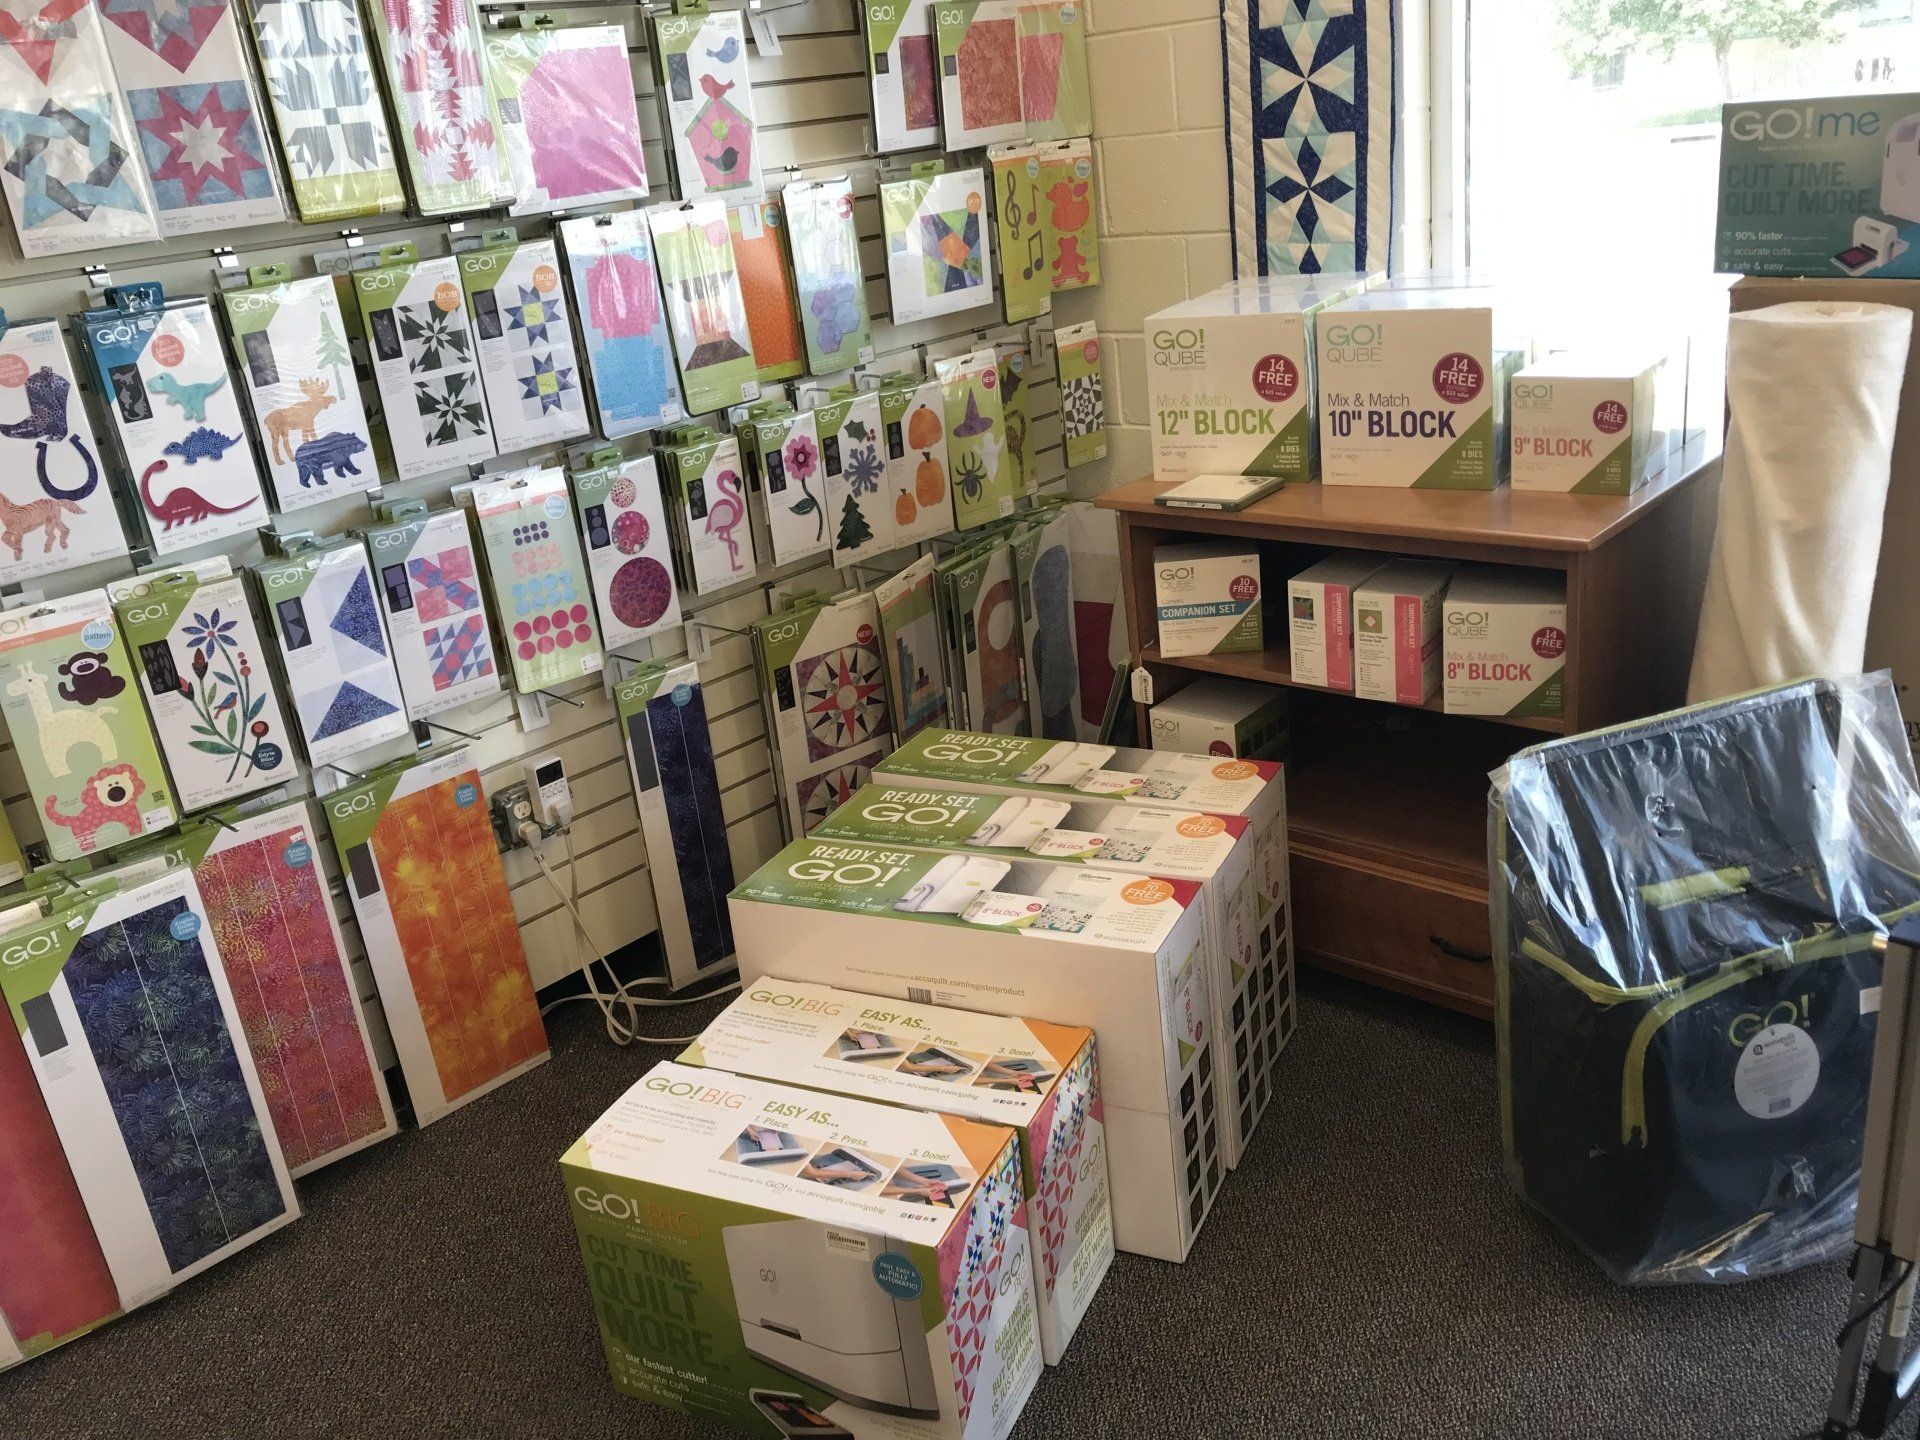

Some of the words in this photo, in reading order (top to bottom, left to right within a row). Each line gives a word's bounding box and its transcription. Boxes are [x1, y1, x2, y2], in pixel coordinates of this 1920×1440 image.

[870, 6, 895, 21] GO!
[940, 10, 964, 25] GO!
[661, 18, 690, 36] GO!
[1726, 164, 1775, 189] CUT
[1724, 191, 1794, 216] QUILT
[1735, 232, 1757, 240] 90%
[1758, 232, 1784, 240] faster
[1734, 248, 1768, 256] accurate
[1771, 248, 1791, 256] cuts
[465, 256, 498, 273] GO!
[1763, 263, 1784, 272] easy
[361, 274, 395, 291] GO!
[96, 324, 138, 345] GO!
[1153, 328, 1204, 350] GO!
[1326, 324, 1383, 346] GO!
[1154, 351, 1206, 366] QUBE
[1326, 347, 1383, 363] QUBE
[1269, 359, 1285, 372] 14
[1451, 357, 1469, 372] 14
[1258, 371, 1293, 387] FREE
[1439, 370, 1478, 388] FREE
[1515, 384, 1553, 399] GO!
[884, 393, 904, 407] GO!
[1157, 395, 1176, 407] Mix
[1180, 394, 1190, 406] &
[1195, 393, 1232, 406] Match
[1328, 393, 1350, 407] Mix
[1354, 394, 1364, 407] &
[1369, 393, 1410, 407] Match
[1515, 399, 1552, 410] QUBE
[1605, 403, 1618, 413] 14
[819, 408, 840, 422] GO!
[1157, 410, 1189, 435] 12"
[1194, 408, 1276, 435] BLOCK
[1597, 411, 1624, 423] FREE
[1329, 410, 1362, 437] 10"
[1368, 410, 1457, 438] BLOCK
[762, 426, 784, 440] GO!
[1514, 437, 1530, 455] 9"
[1533, 438, 1593, 458] BLOCK
[682, 453, 706, 468] GO!
[579, 472, 607, 491] GO!
[375, 531, 407, 549] GO!
[269, 568, 303, 588] GO!
[960, 571, 979, 589] GO!
[1160, 566, 1194, 580] GO!
[1160, 580, 1194, 590] QUBE
[1232, 585, 1255, 594] FREE
[1239, 577, 1250, 586] 10
[128, 603, 168, 623] GO!
[1161, 605, 1216, 618] COMPANION
[1218, 604, 1237, 613] SET
[1335, 592, 1343, 626] COMPANION
[1447, 612, 1488, 625] GO!
[84, 632, 111, 642] pattern
[768, 623, 799, 643] GO!
[1447, 626, 1488, 636] QUBE
[1545, 630, 1557, 639] 14
[1536, 638, 1563, 648] FREE
[1478, 652, 1508, 661] Match
[1448, 662, 1465, 679] 8"
[1468, 663, 1533, 681] BLOCK
[621, 684, 648, 700] GO!
[1152, 718, 1180, 733] GO!
[922, 744, 1022, 766] GO!
[1216, 768, 1249, 777] FREE
[334, 791, 376, 818] GO!
[862, 803, 969, 827] GO!
[1180, 824, 1219, 834] FREE
[788, 859, 902, 888] GO!
[1125, 889, 1167, 899] FREE
[2, 930, 61, 965] GO!
[914, 975, 1025, 997] accuquilt.com/registerproduct
[860, 1009, 900, 1024] EASY
[1729, 994, 1811, 1047] GO!
[860, 1021, 886, 1033] Place.
[934, 1035, 960, 1047] Press.
[1008, 1048, 1035, 1057] Done!
[762, 1101, 809, 1119] EASY
[763, 1117, 790, 1129] Place.
[840, 1135, 869, 1147] Press.
[922, 1150, 950, 1161] Done!
[1075, 1189, 1098, 1235] QUILTING
[646, 1203, 700, 1238] BIG
[586, 1234, 629, 1265] CUT
[1072, 1247, 1084, 1274] BUT
[1079, 1253, 1092, 1282] JUST
[759, 1269, 777, 1284] GO!
[879, 1274, 918, 1290] AUTOMATIC!
[889, 1270, 907, 1280] FULLY
[593, 1261, 698, 1323] QUILT
[995, 1304, 1022, 1354] QUILTING
[1001, 1304, 1032, 1361] CREATING
[992, 1367, 1007, 1397] BUT
[1006, 1319, 1032, 1371] CUTTING
[625, 1353, 640, 1364] our
[643, 1357, 674, 1375] fastest
[678, 1369, 708, 1384] cutter!
[629, 1366, 667, 1386] accurate
[670, 1379, 690, 1392] cuts
[1000, 1368, 1016, 1402] JUST
[632, 1379, 649, 1390] safe
[663, 1389, 683, 1402] easy
